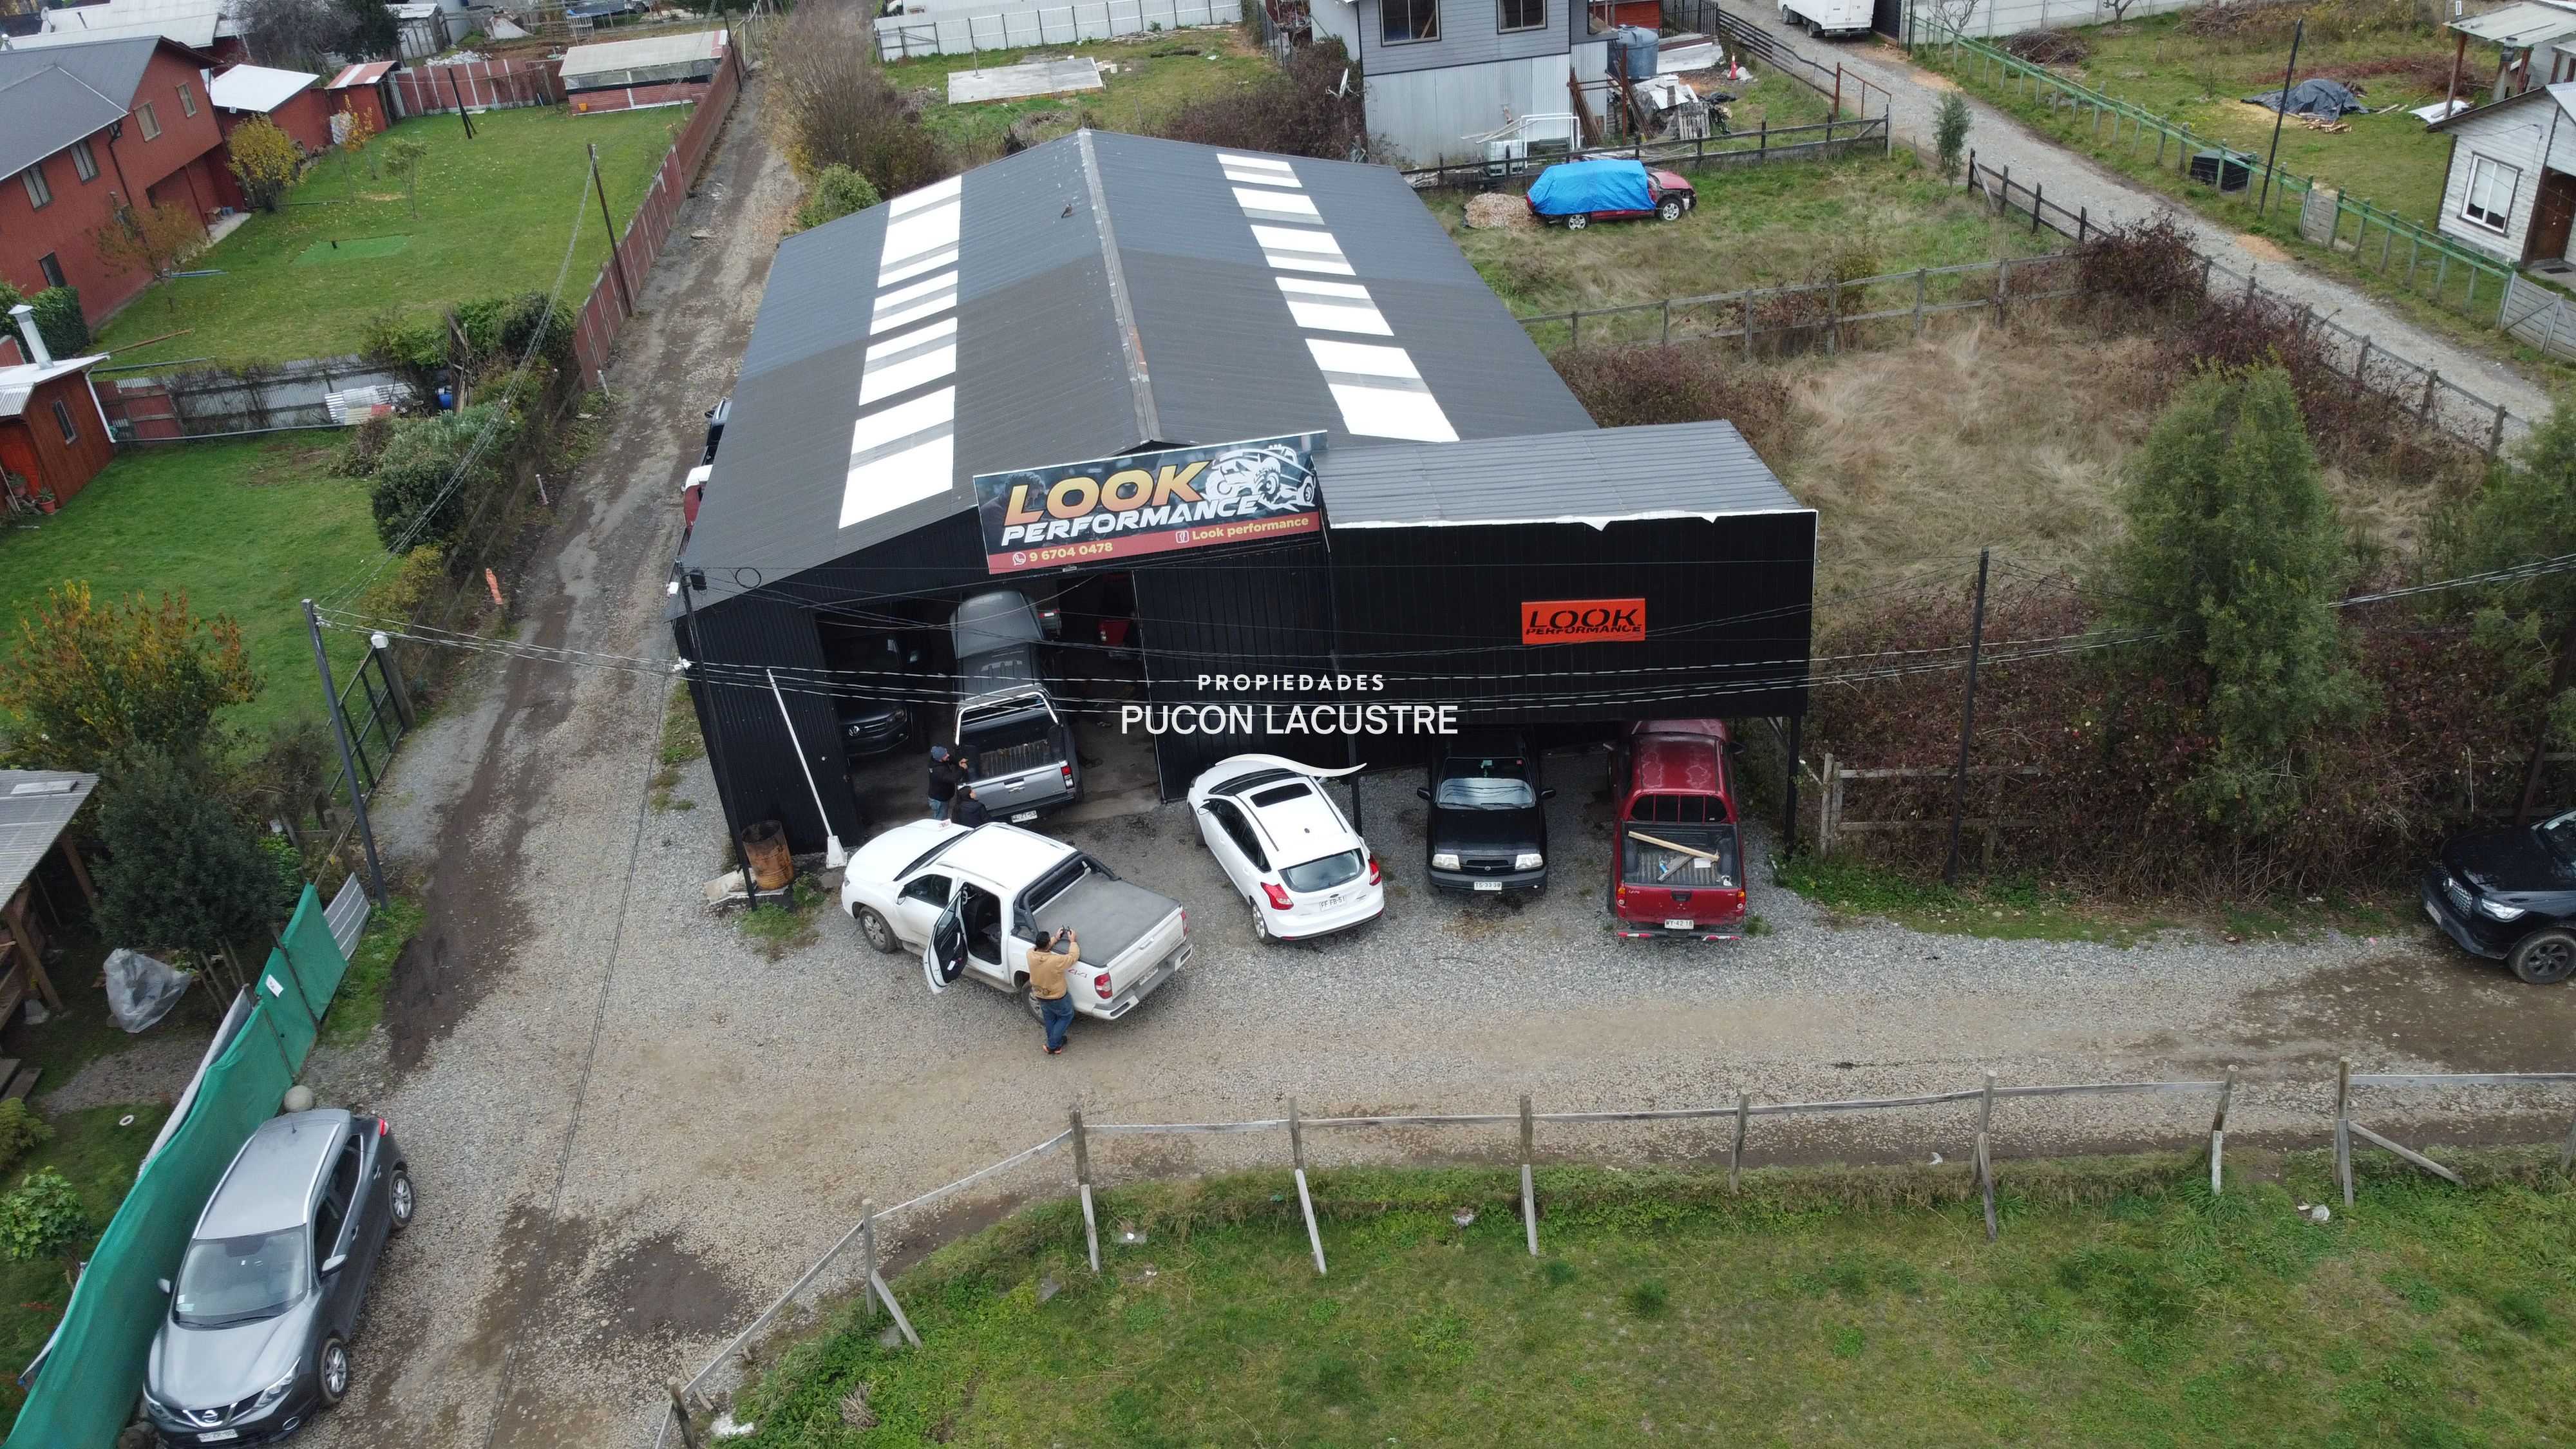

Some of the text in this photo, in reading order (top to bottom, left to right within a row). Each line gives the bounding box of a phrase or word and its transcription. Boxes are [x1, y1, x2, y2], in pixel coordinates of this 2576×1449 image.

[1003, 459, 1213, 526] LOOK
[1001, 494, 1262, 546] PERFORMANCE
[1192, 518, 1309, 540] Look performance
[1029, 542, 1113, 562] 9 6704 0478
[1526, 624, 1642, 635] PERFORMANCE
[1529, 609, 1638, 629] LOOK
